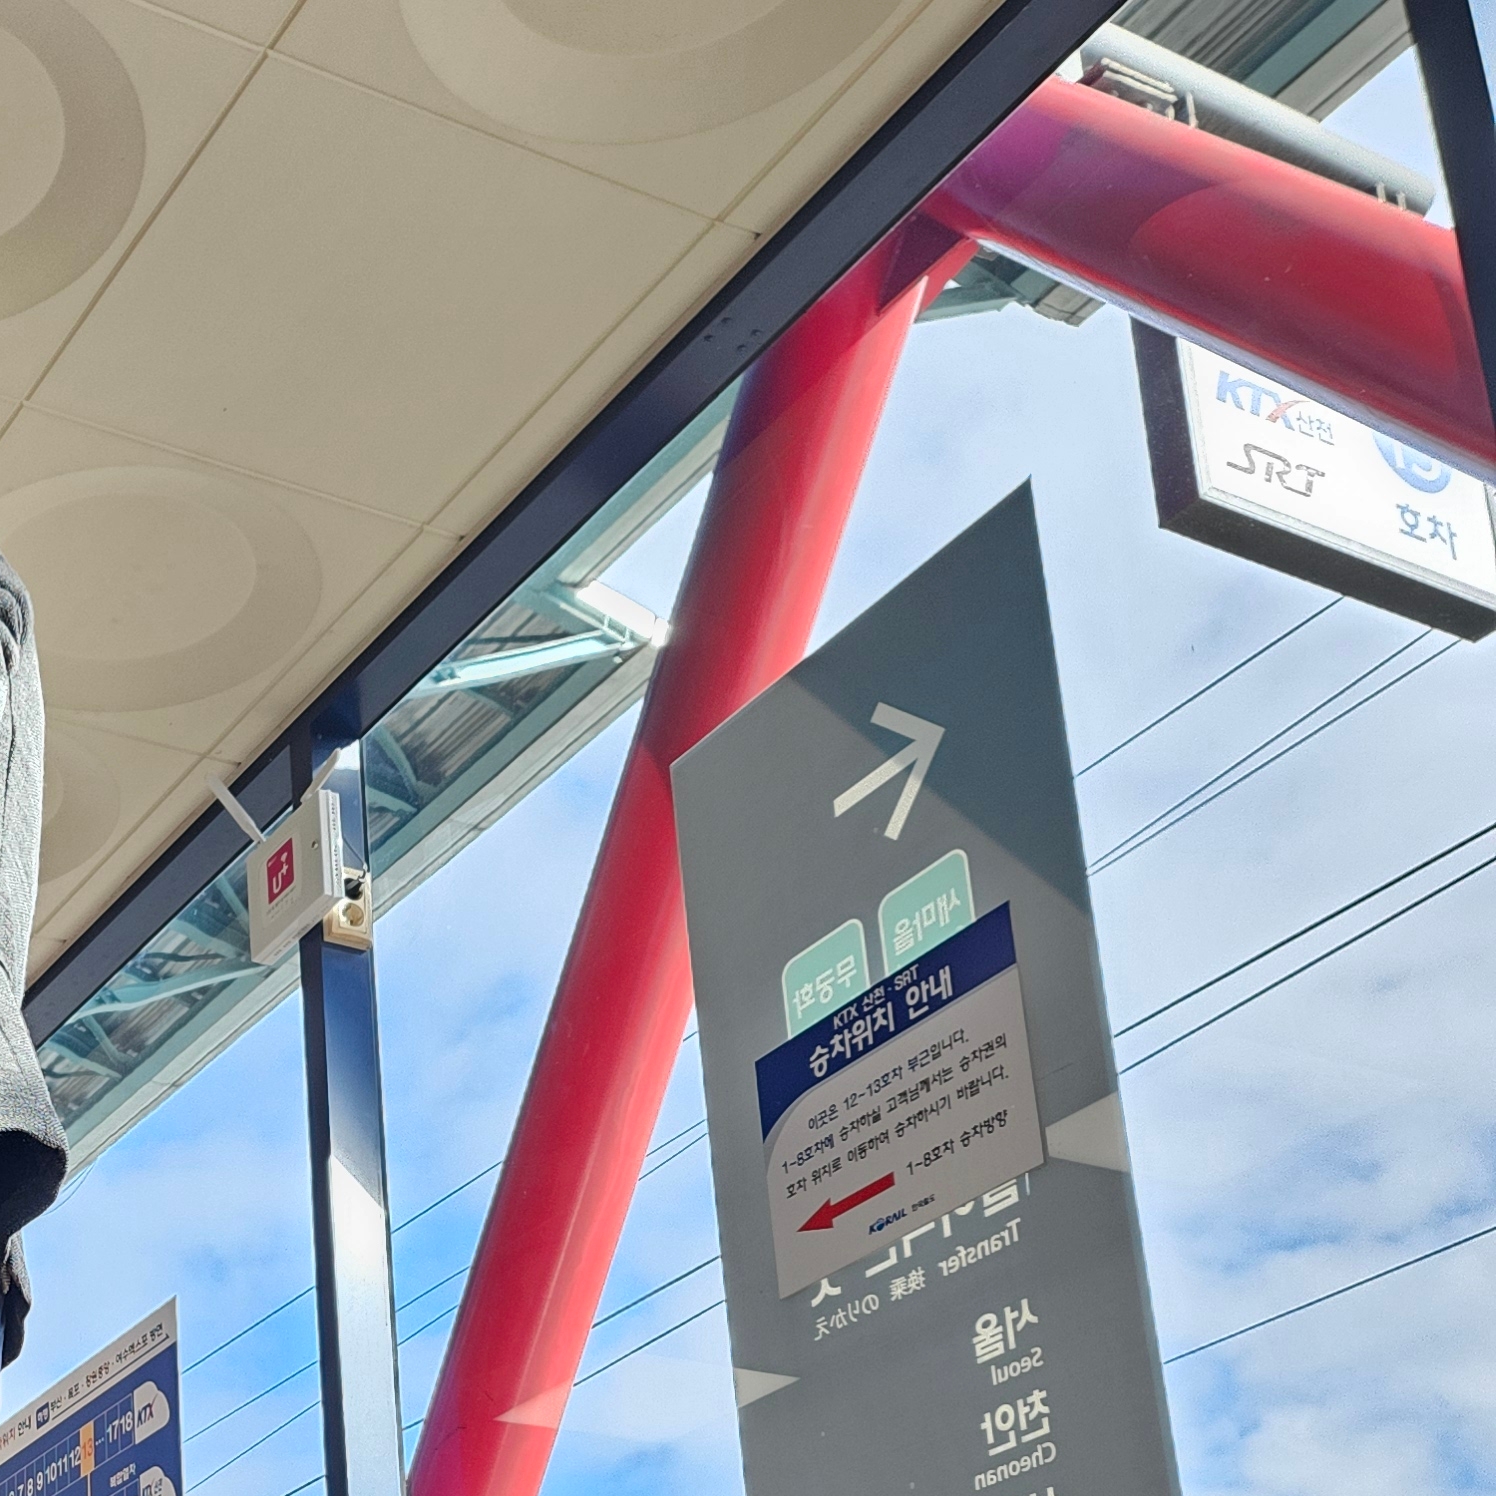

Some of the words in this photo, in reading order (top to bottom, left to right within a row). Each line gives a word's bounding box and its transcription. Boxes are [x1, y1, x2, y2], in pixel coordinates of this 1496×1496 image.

[1215, 370, 1308, 431] KTX
[1226, 443, 1326, 497] SRT
[1396, 503, 1457, 561] 호차
[808, 1001, 895, 1079] 승차위치
[905, 965, 954, 1020] 안내
[833, 1007, 859, 1030] KTX
[862, 988, 886, 1012] 산천
[894, 964, 920, 991] SRT
[958, 1033, 1008, 1072] 승차권의
[808, 1104, 839, 1130] 이곳은
[811, 1157, 843, 1186] 위치로
[847, 1128, 891, 1163] 이동하여
[894, 1094, 952, 1139] 승차하시기
[959, 1109, 1009, 1149] 승차방향
[868, 1208, 908, 1236] KORAIL
[27, 1478, 33, 1496] 8
[37, 1471, 43, 1491] 9
[45, 1462, 57, 1484] 10
[57, 1454, 68, 1476] 11
[69, 1446, 81, 1468] 12
[82, 1438, 93, 1459] 13
[106, 1420, 119, 1443] 17
[120, 1410, 133, 1434] 18
